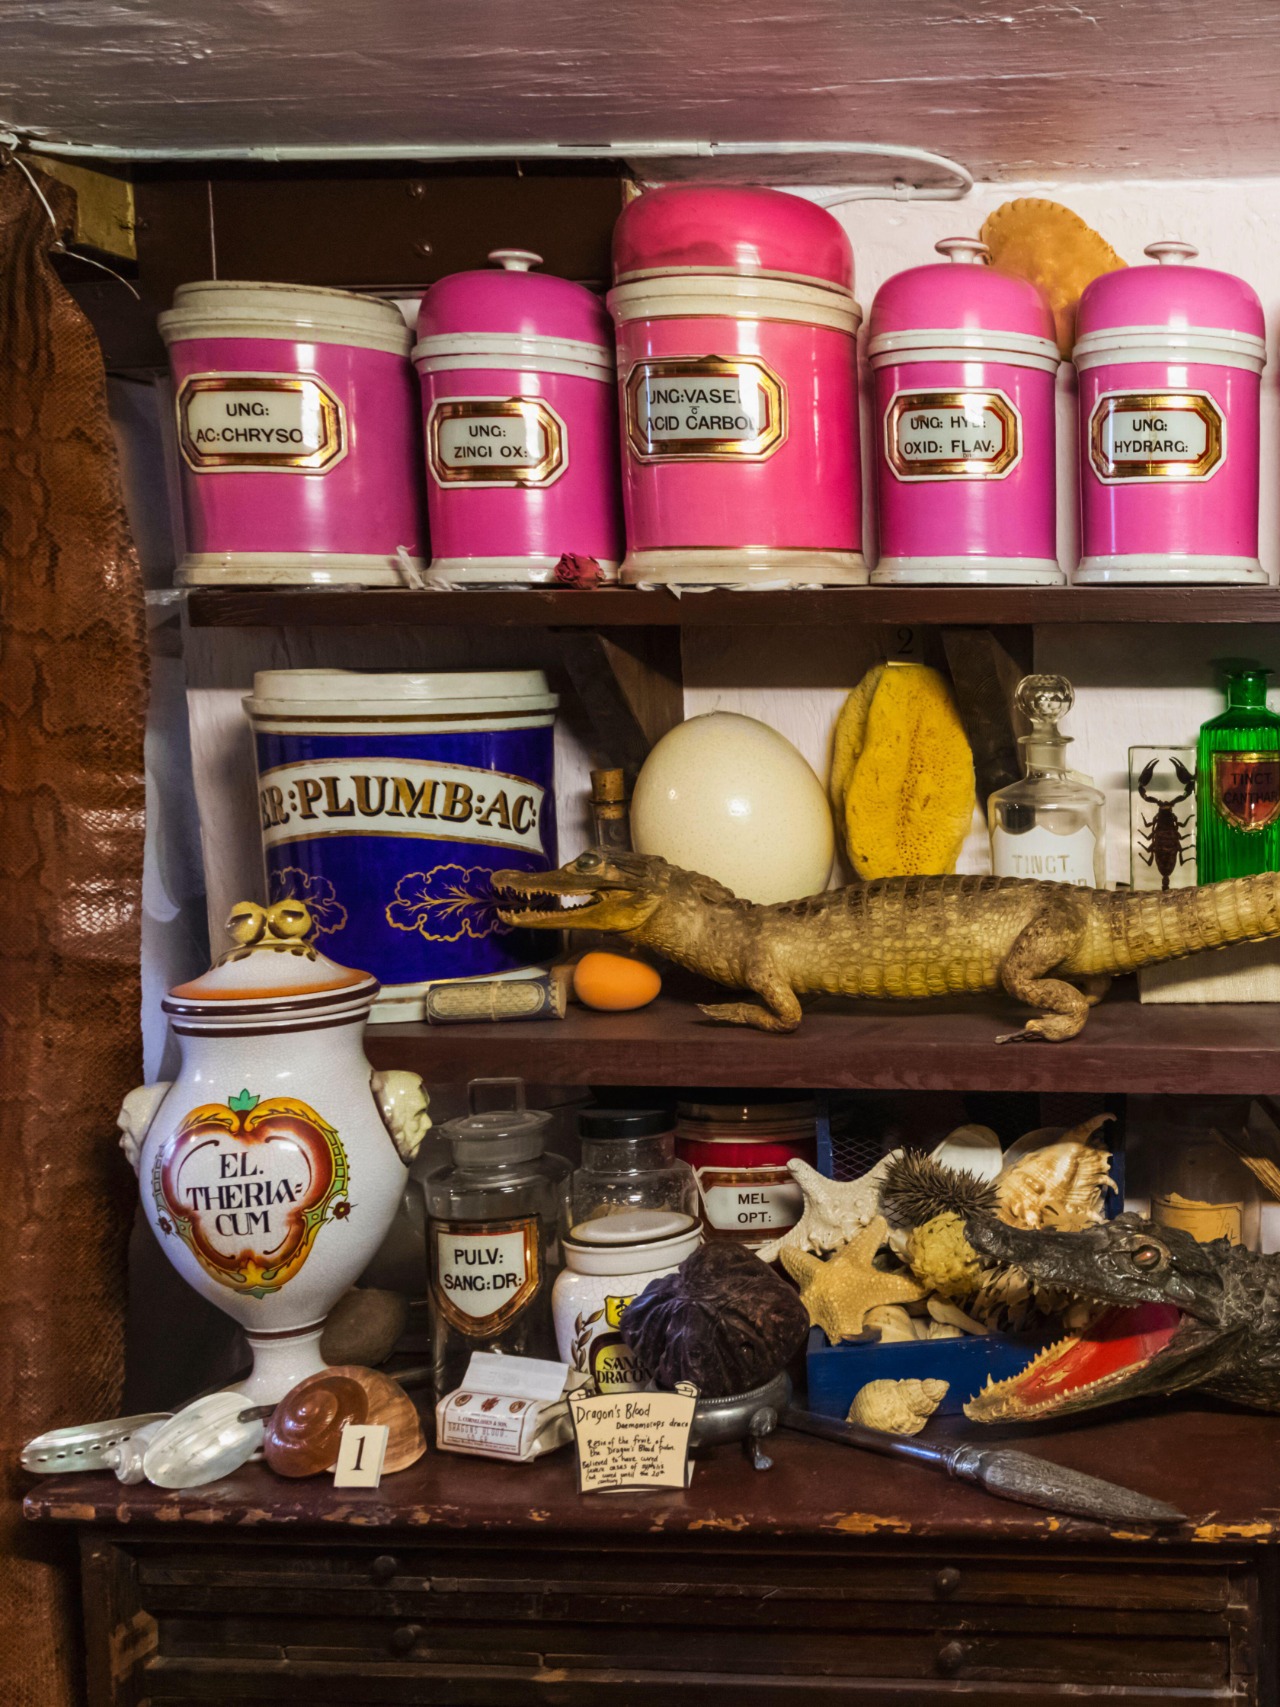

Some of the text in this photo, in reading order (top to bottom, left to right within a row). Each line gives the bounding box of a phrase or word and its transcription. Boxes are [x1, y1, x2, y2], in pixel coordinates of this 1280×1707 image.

[225, 402, 270, 417] UNG:
[645, 415, 679, 432] ACID
[910, 416, 944, 430] UNG:
[1132, 418, 1168, 432] UNG:
[468, 425, 507, 438] UNG:
[453, 445, 529, 459] ZINCI OX:
[904, 439, 995, 455] OXID: FLAV:
[1113, 440, 1189, 453] HYDRARG:
[1011, 854, 1074, 874] TINCT.
[218, 1151, 264, 1180] EL.
[737, 1192, 770, 1205] MEL
[214, 1210, 271, 1238] CUM
[737, 1211, 772, 1224] OPT:
[453, 1247, 504, 1266] PULV:
[576, 1402, 651, 1425] Dragon's Blood
[633, 1434, 651, 1446] fruit
[655, 1434, 665, 1446] of
[350, 1435, 364, 1471] 1
